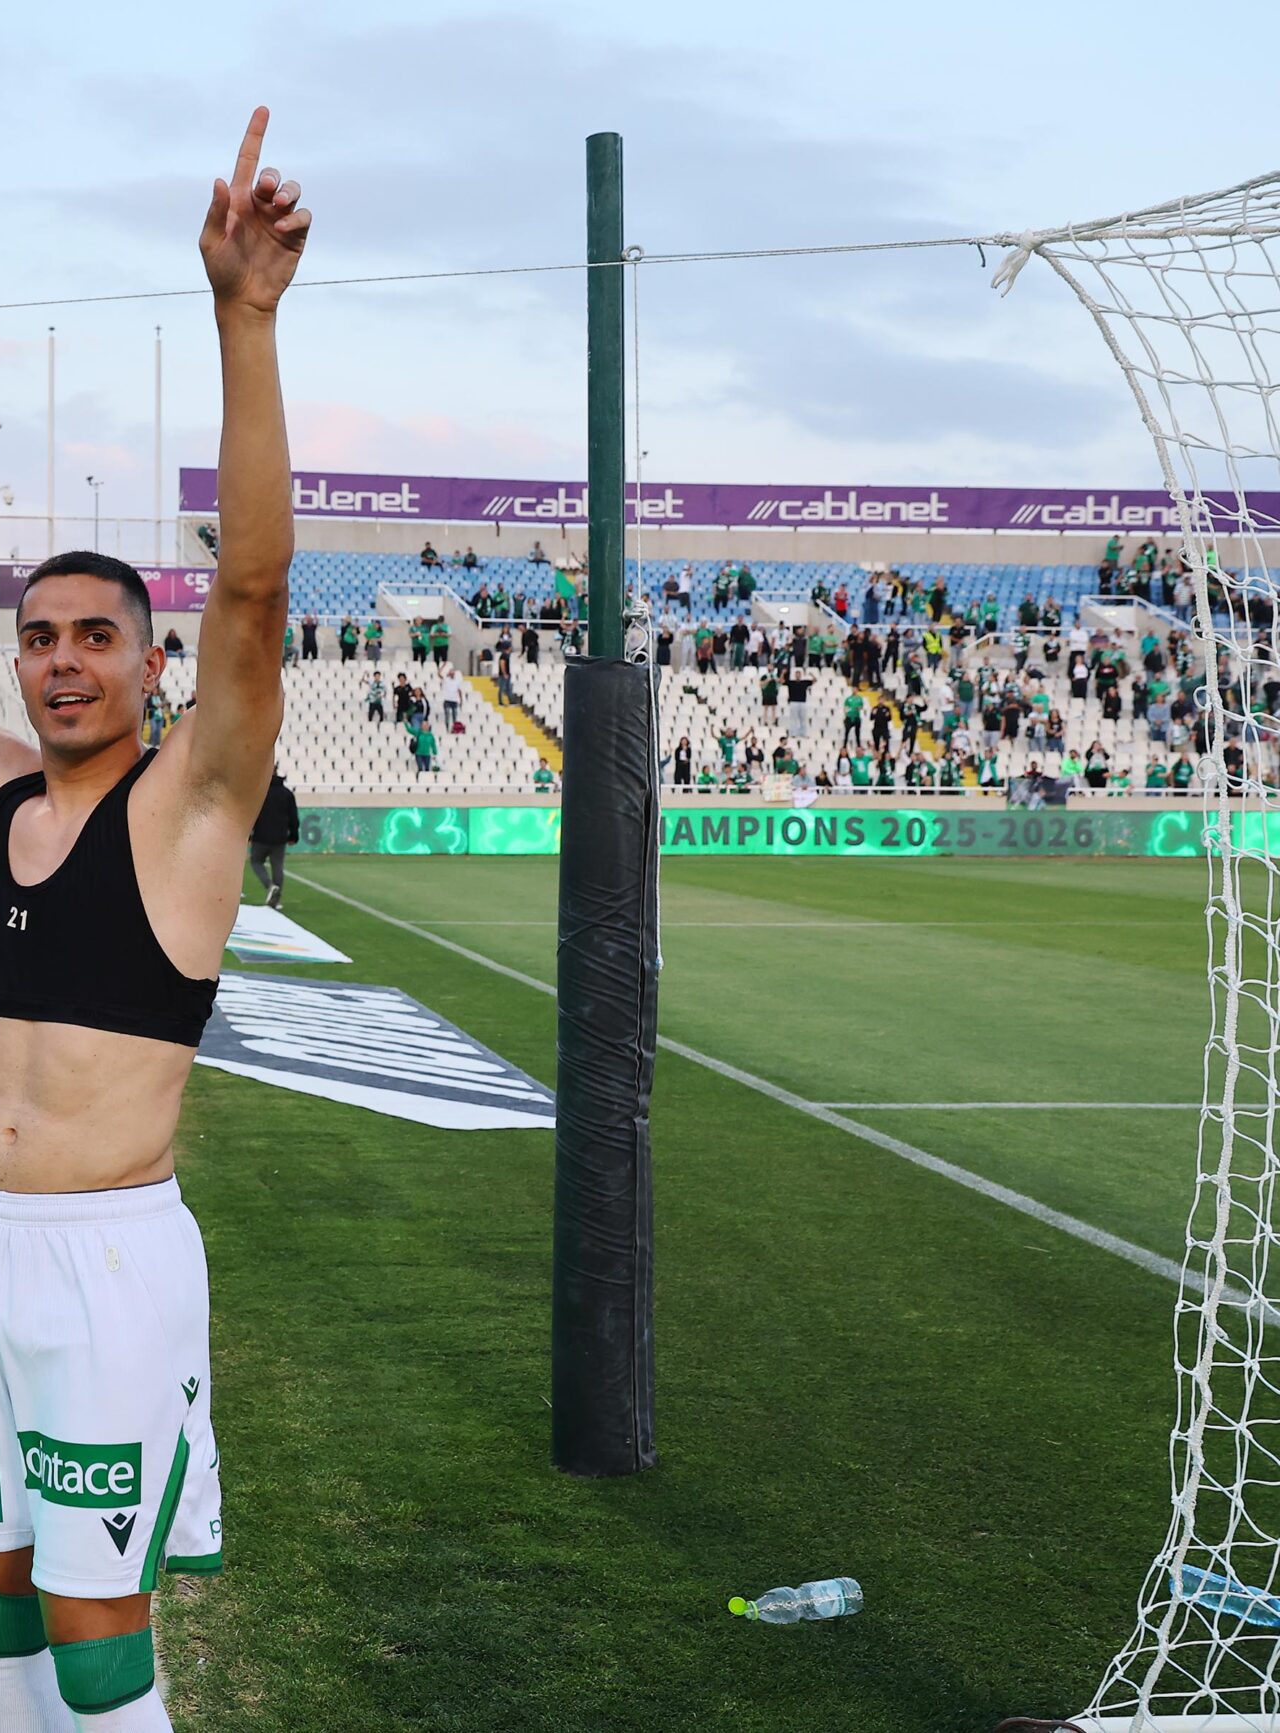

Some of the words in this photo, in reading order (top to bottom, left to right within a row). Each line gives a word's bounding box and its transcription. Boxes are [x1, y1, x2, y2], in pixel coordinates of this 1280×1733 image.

[293, 479, 419, 513] blenet
[513, 487, 684, 519] cablnet
[778, 491, 949, 523] cablenet
[660, 816, 866, 847] AMPIONS
[880, 816, 1095, 848] 2025-2026
[6, 906, 28, 931] 21
